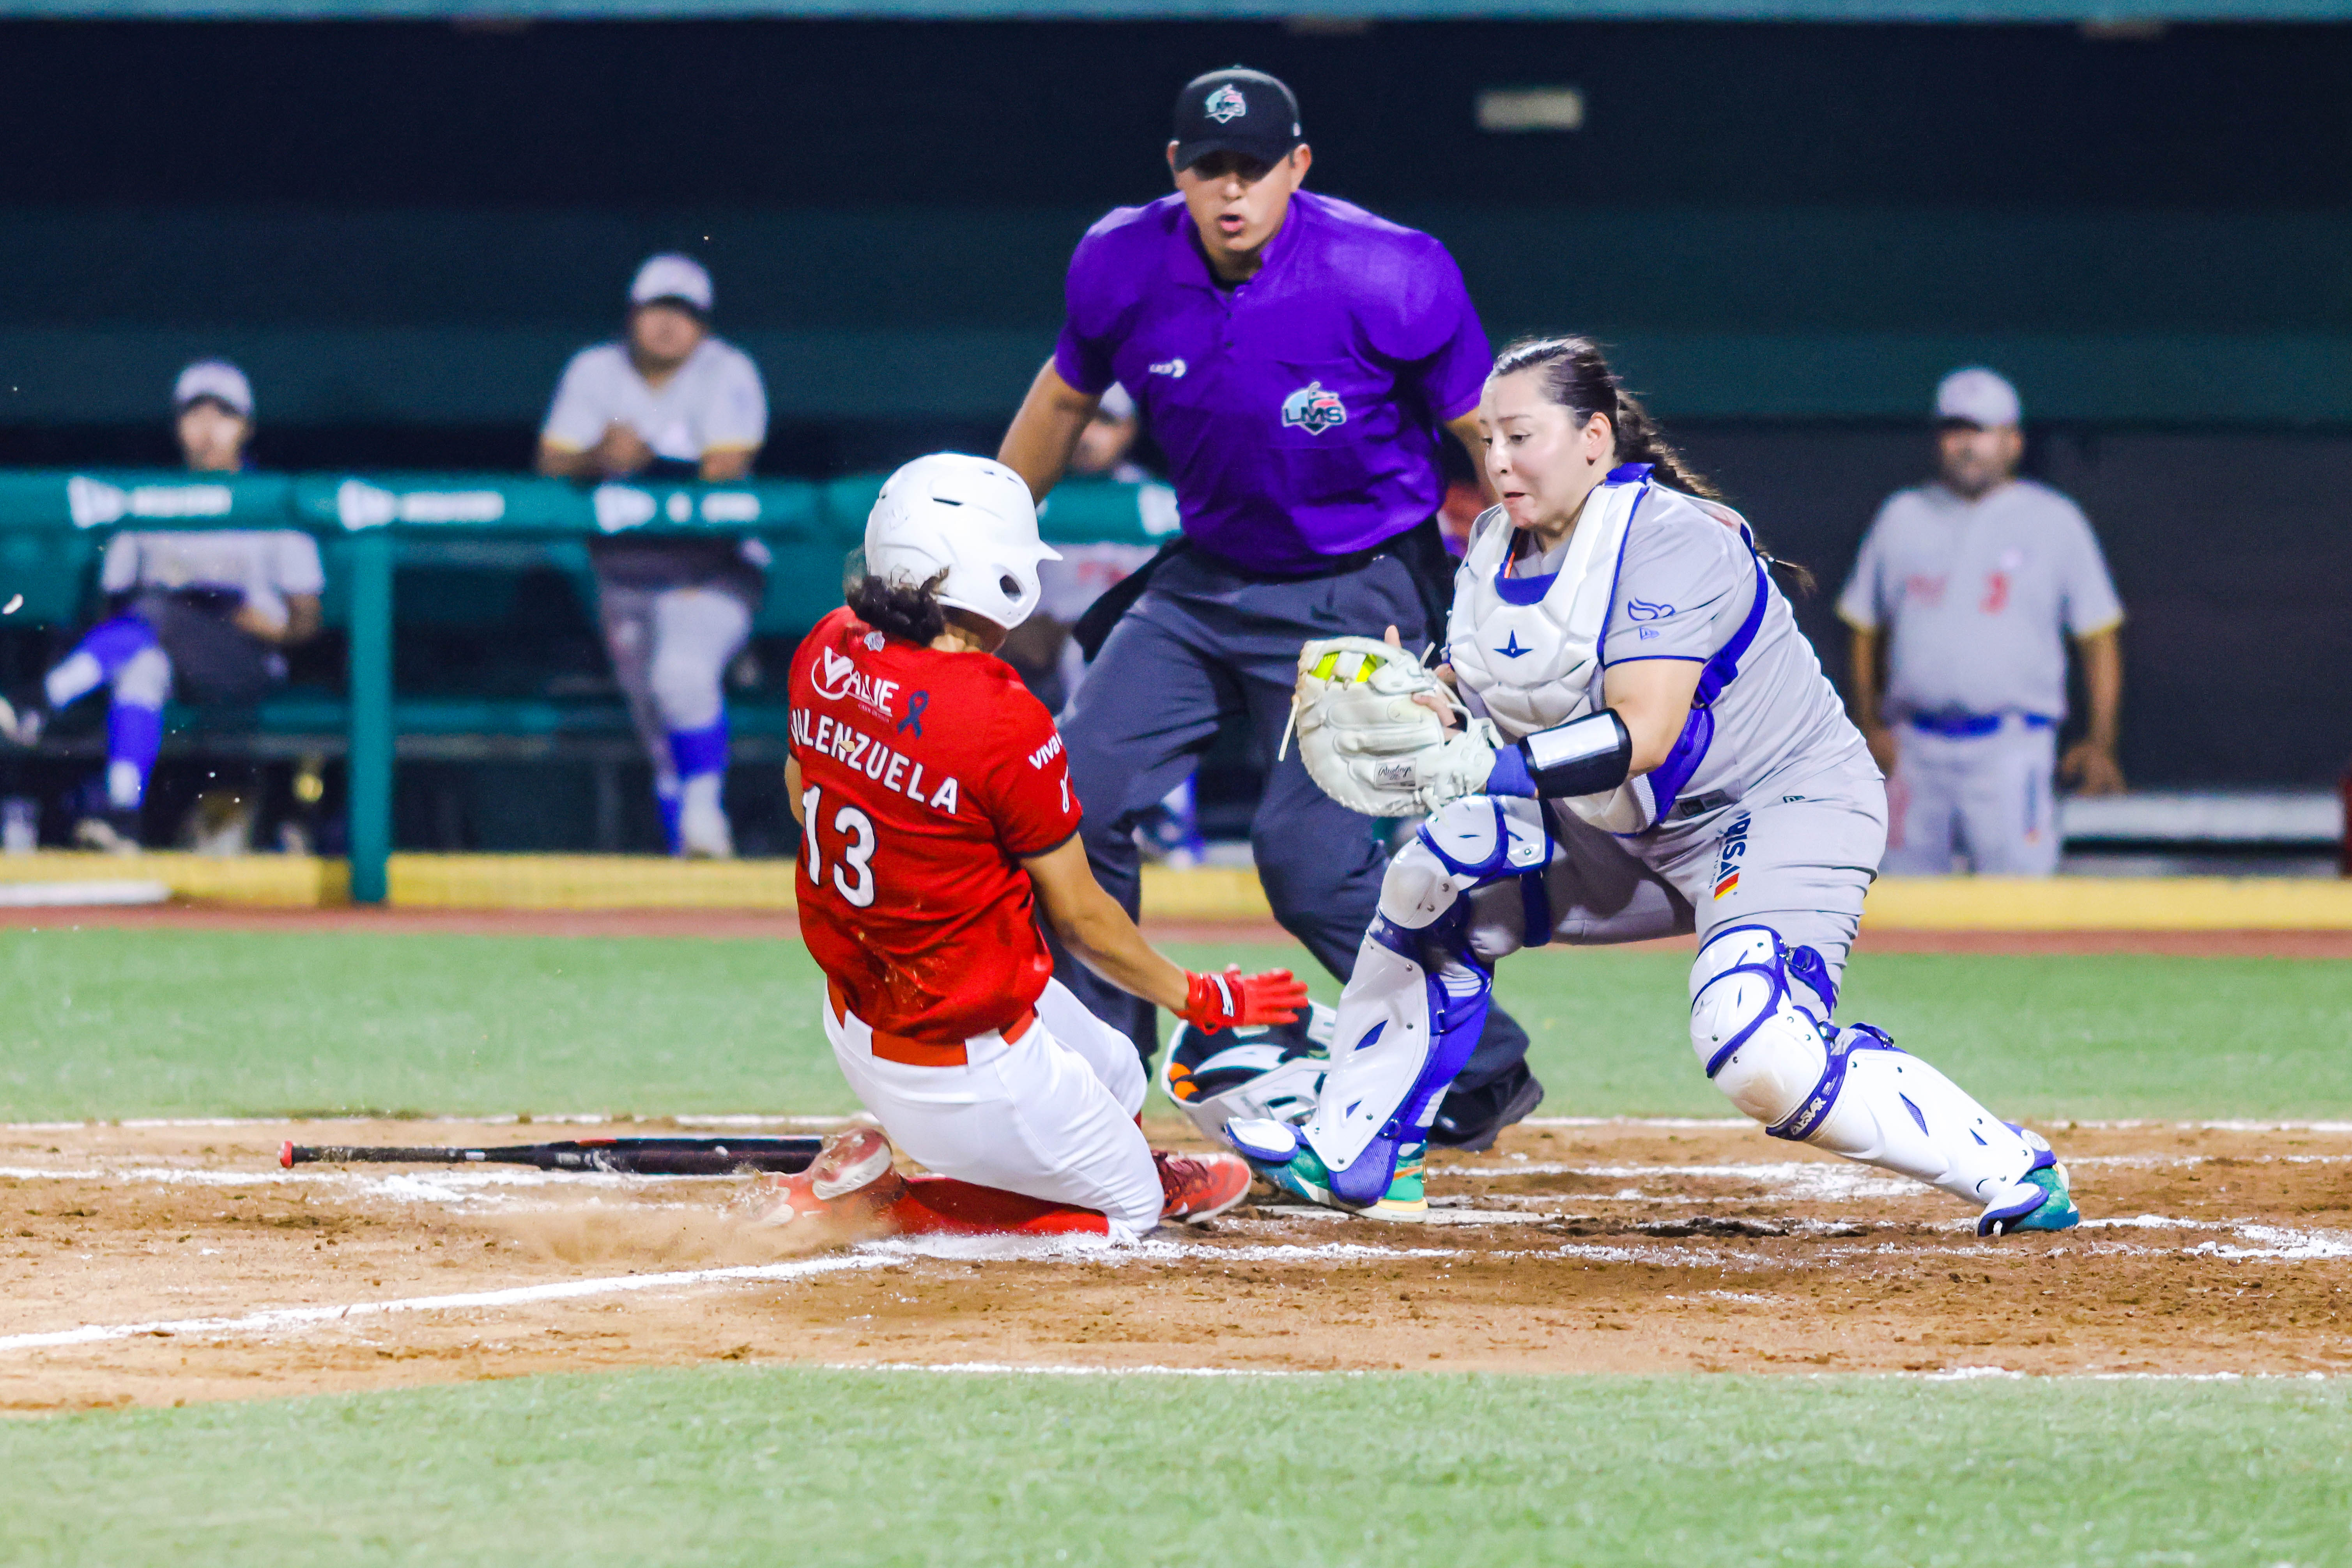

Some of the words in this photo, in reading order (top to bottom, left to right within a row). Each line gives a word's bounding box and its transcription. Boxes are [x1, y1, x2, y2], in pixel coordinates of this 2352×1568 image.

[1285, 407, 1343, 423] LMS
[802, 785, 875, 907] 13
[1716, 812, 1751, 883] RISA
